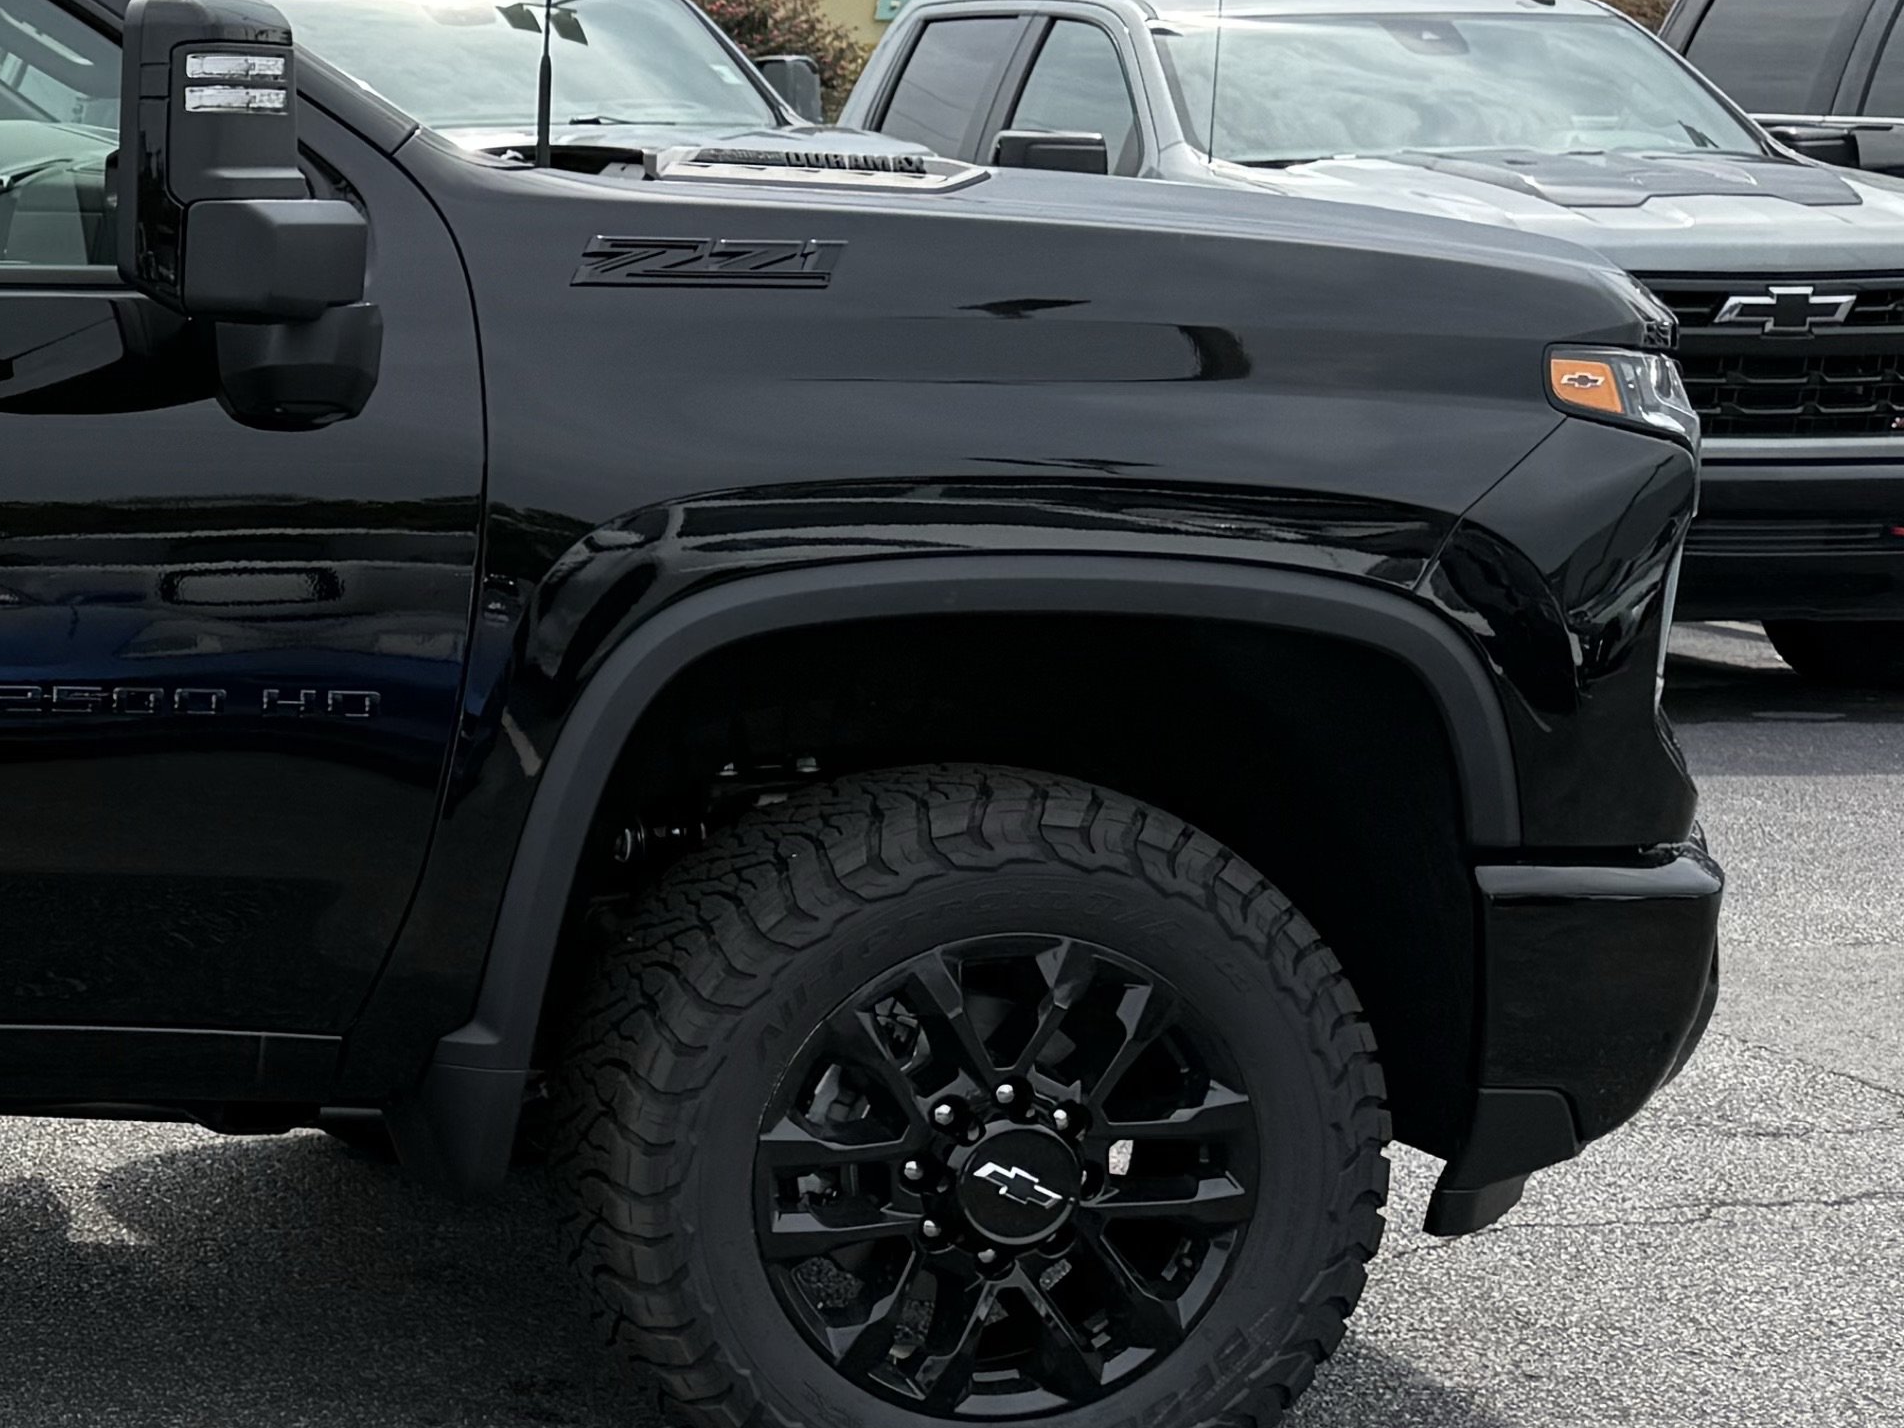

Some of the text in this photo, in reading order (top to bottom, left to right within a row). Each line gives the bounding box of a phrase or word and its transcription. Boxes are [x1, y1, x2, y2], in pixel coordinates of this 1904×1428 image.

[784, 151, 927, 174] DURAMAX
[570, 235, 848, 289] Z71
[261, 688, 382, 719] HD
